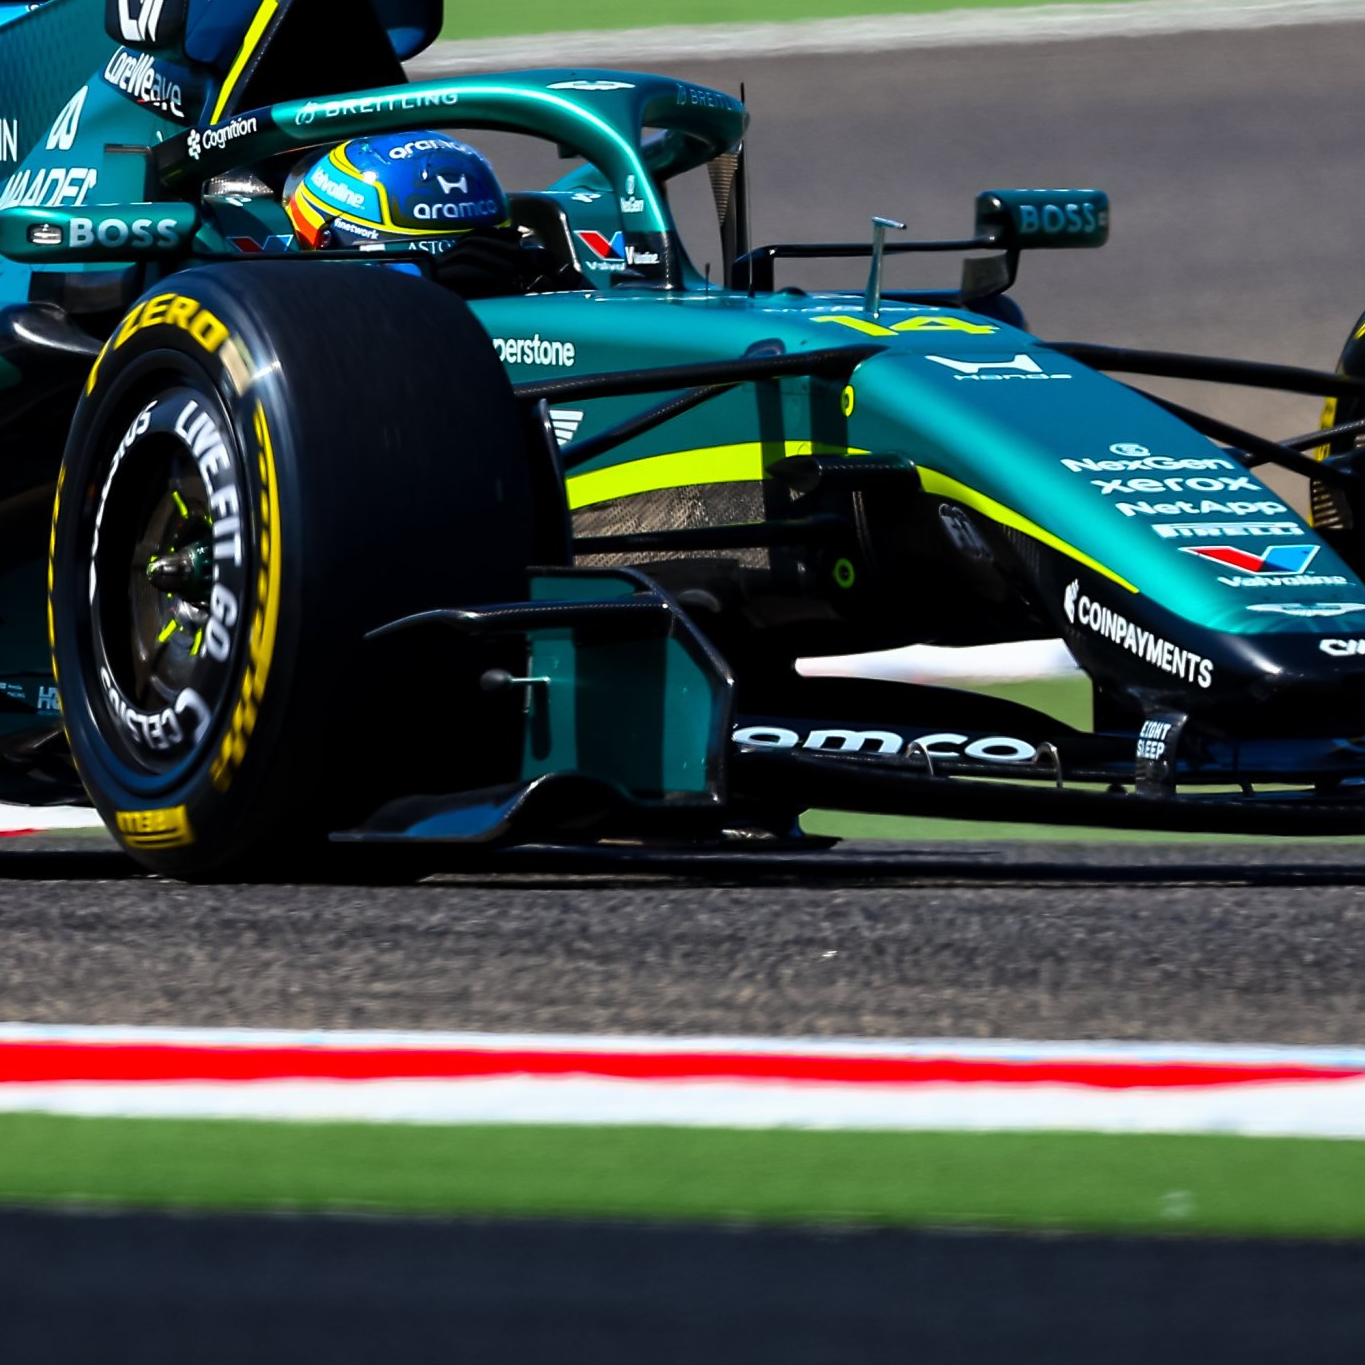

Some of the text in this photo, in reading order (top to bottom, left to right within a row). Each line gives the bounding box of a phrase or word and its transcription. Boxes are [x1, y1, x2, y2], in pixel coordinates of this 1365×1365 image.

[104, 45, 185, 118] CoreWeave
[325, 92, 459, 118] BREITLING
[202, 116, 258, 151] Cognition
[413, 198, 499, 220] aramco
[1019, 202, 1095, 234] BOSS
[69, 217, 179, 249] BOSS
[408, 239, 457, 256] ASTO
[113, 292, 231, 354] ZERO
[809, 315, 1002, 337] 14
[492, 333, 575, 366] perstone
[1060, 456, 1236, 473] NexGen
[1091, 476, 1263, 495] xerox
[1115, 499, 1288, 517] NetApp
[1151, 521, 1305, 538] PIRELLI
[1217, 575, 1349, 588] Valvoline
[1078, 595, 1214, 689] COINPAYMENTS
